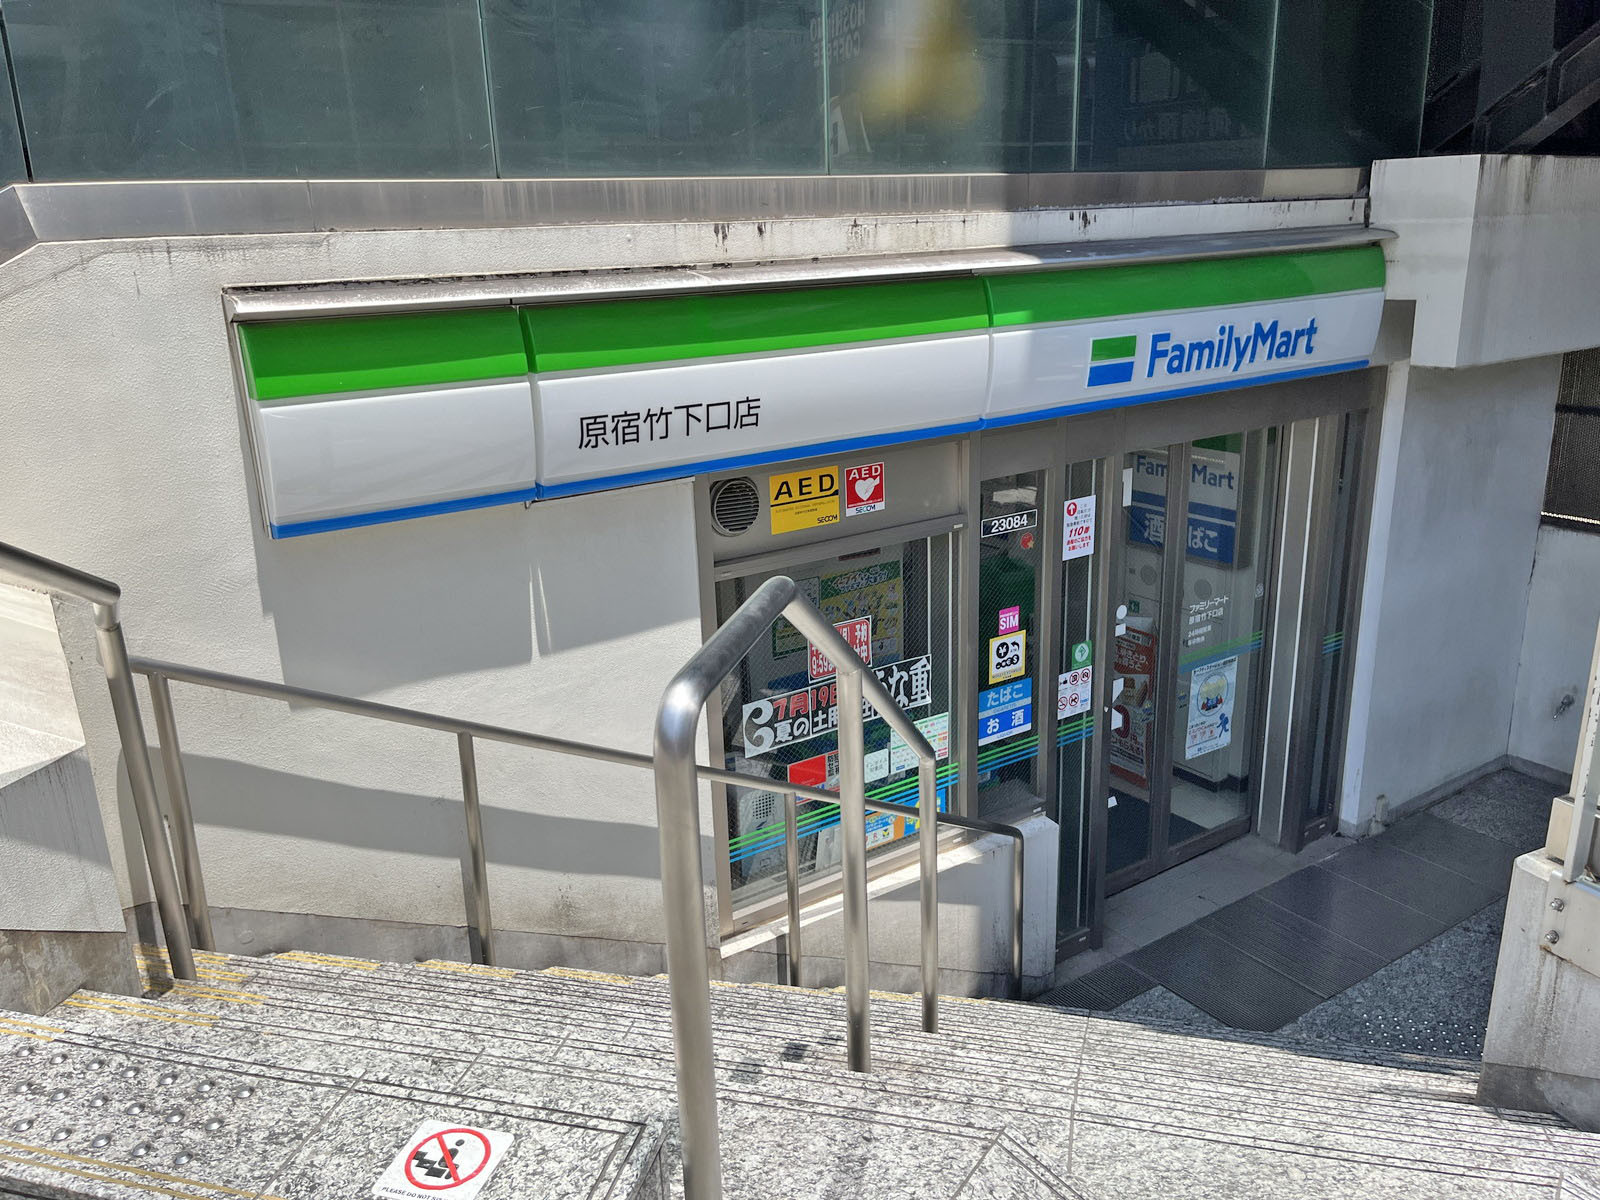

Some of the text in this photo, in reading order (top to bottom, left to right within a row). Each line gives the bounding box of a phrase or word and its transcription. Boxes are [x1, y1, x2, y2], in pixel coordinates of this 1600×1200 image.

[1147, 317, 1318, 378] FamilyMart
[578, 396, 761, 449] 原宿竹下口店
[849, 465, 881, 480] AED
[774, 473, 835, 500] AED
[855, 504, 876, 514] SECOM
[991, 514, 1028, 533] 23084
[1189, 595, 1229, 614] ファミリーマート
[1000, 613, 1019, 630] SIM
[987, 684, 1024, 707] たばこ
[381, 1186, 407, 1195] PLEASE
